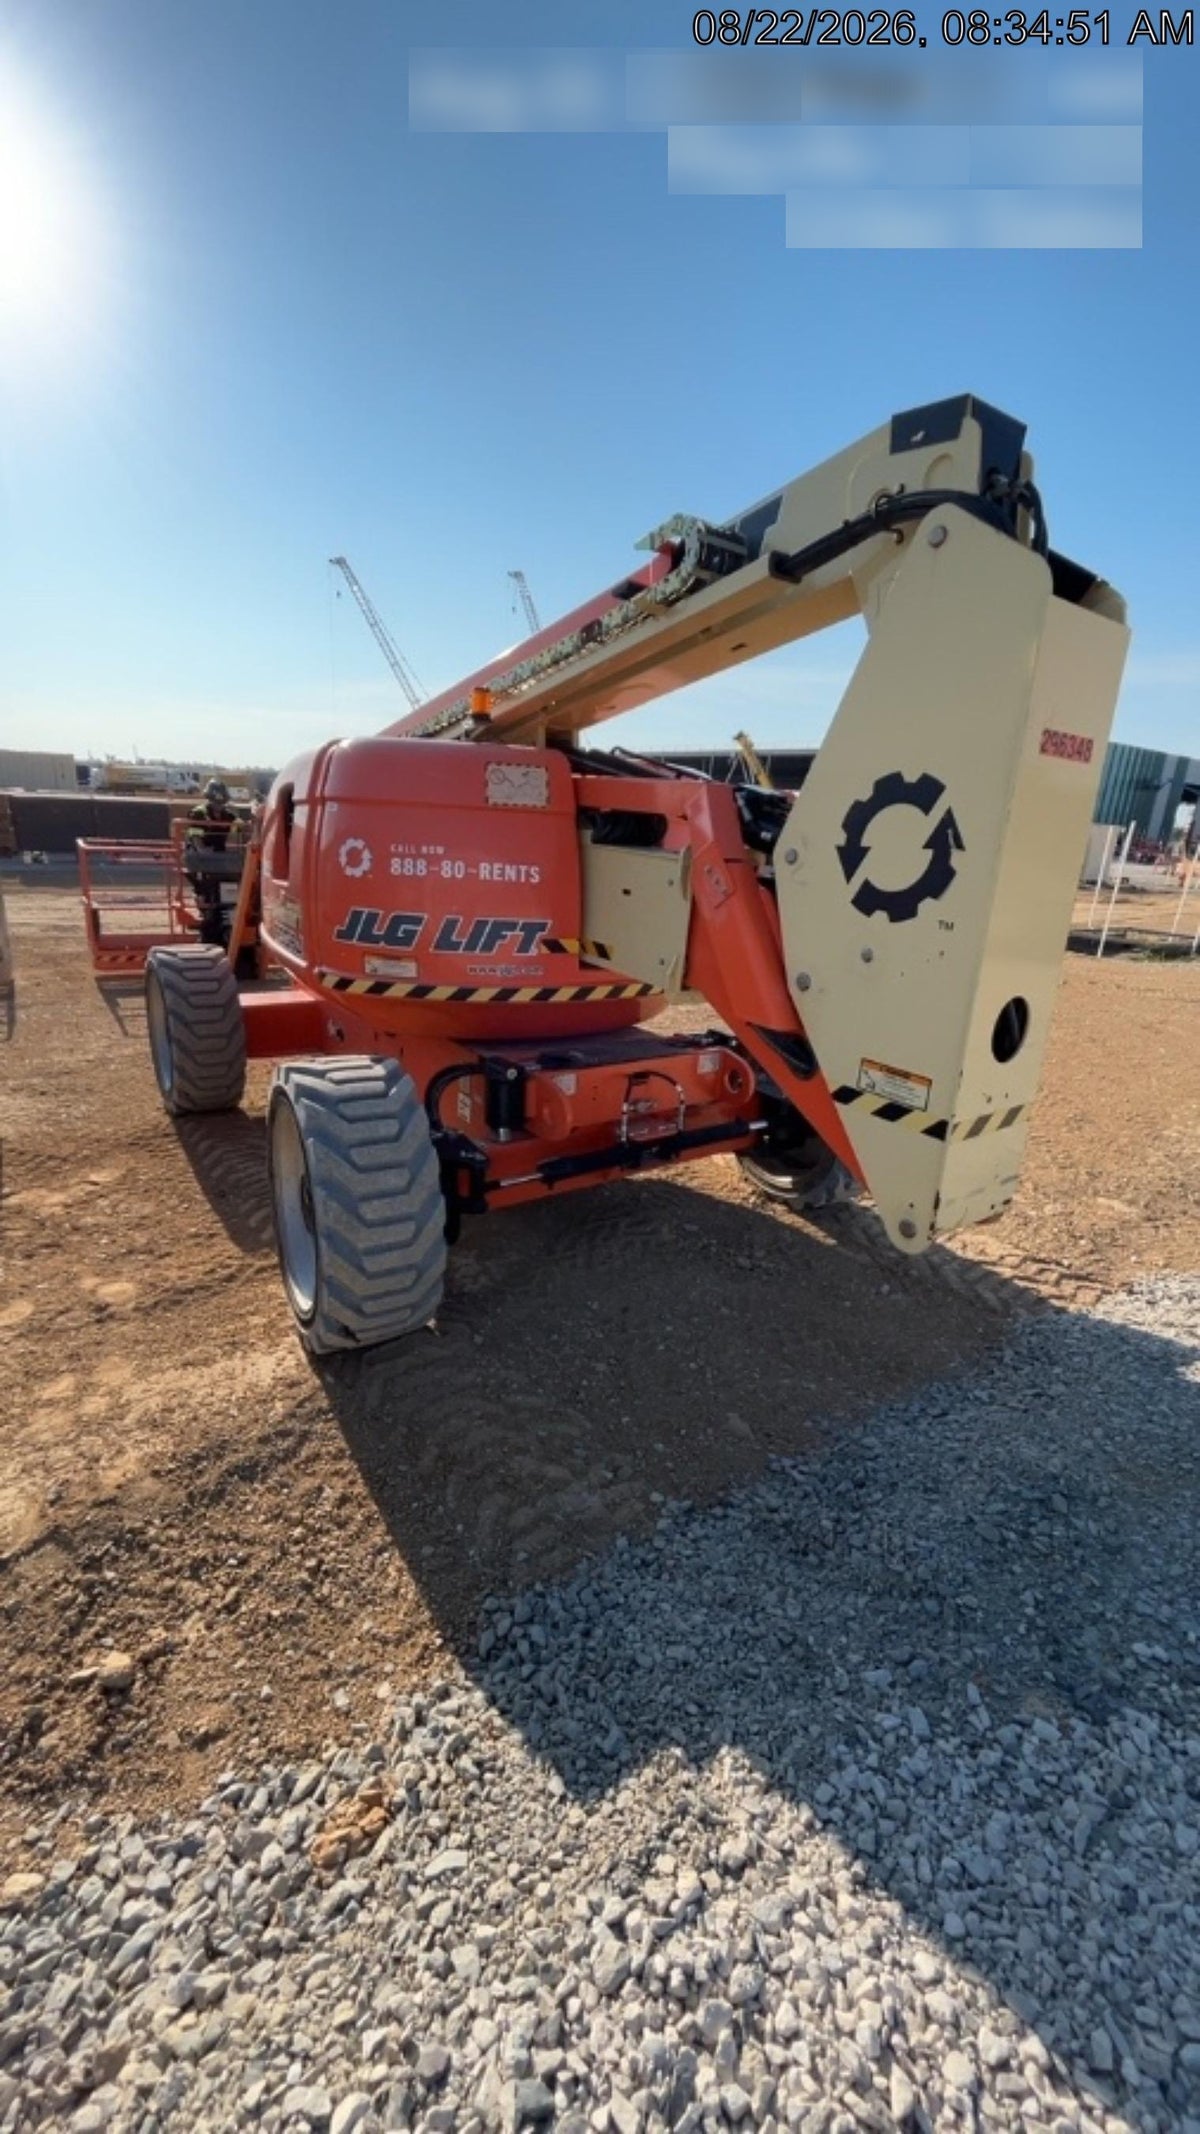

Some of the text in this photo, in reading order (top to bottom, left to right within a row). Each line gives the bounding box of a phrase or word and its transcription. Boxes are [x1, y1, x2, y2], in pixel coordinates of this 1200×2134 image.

[390, 843, 445, 855] CALL NOW
[390, 857, 541, 883] 888-80-RENTS
[332, 907, 428, 950] JLG
[430, 915, 553, 956] LIFT
